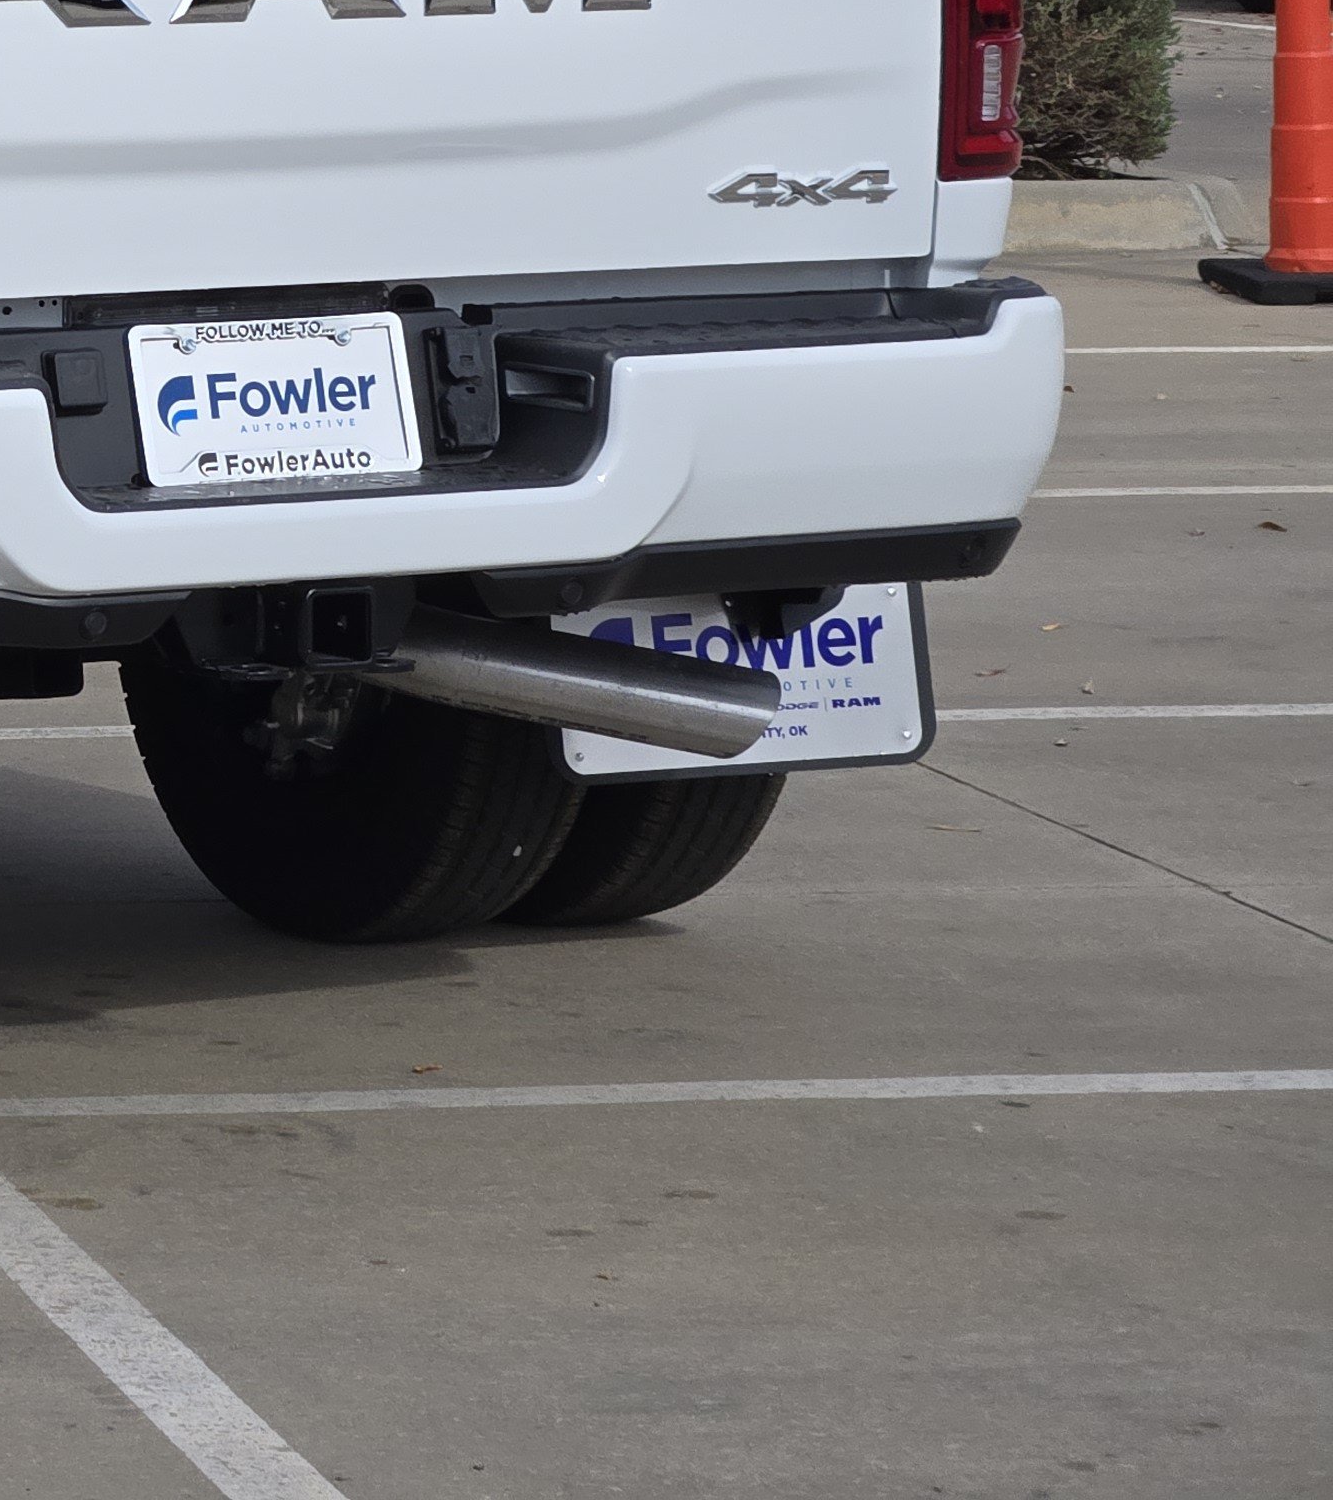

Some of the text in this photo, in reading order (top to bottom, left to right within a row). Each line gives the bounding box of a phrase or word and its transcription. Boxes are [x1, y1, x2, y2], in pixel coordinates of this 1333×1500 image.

[706, 162, 898, 208] 4x4
[195, 323, 265, 342] FOLLOW
[270, 322, 294, 337] ME
[206, 367, 376, 419] Fowler
[240, 418, 356, 434] AUTOMOTIVE
[776, 696, 881, 712] ODGE RAM
[789, 725, 808, 737] OK
